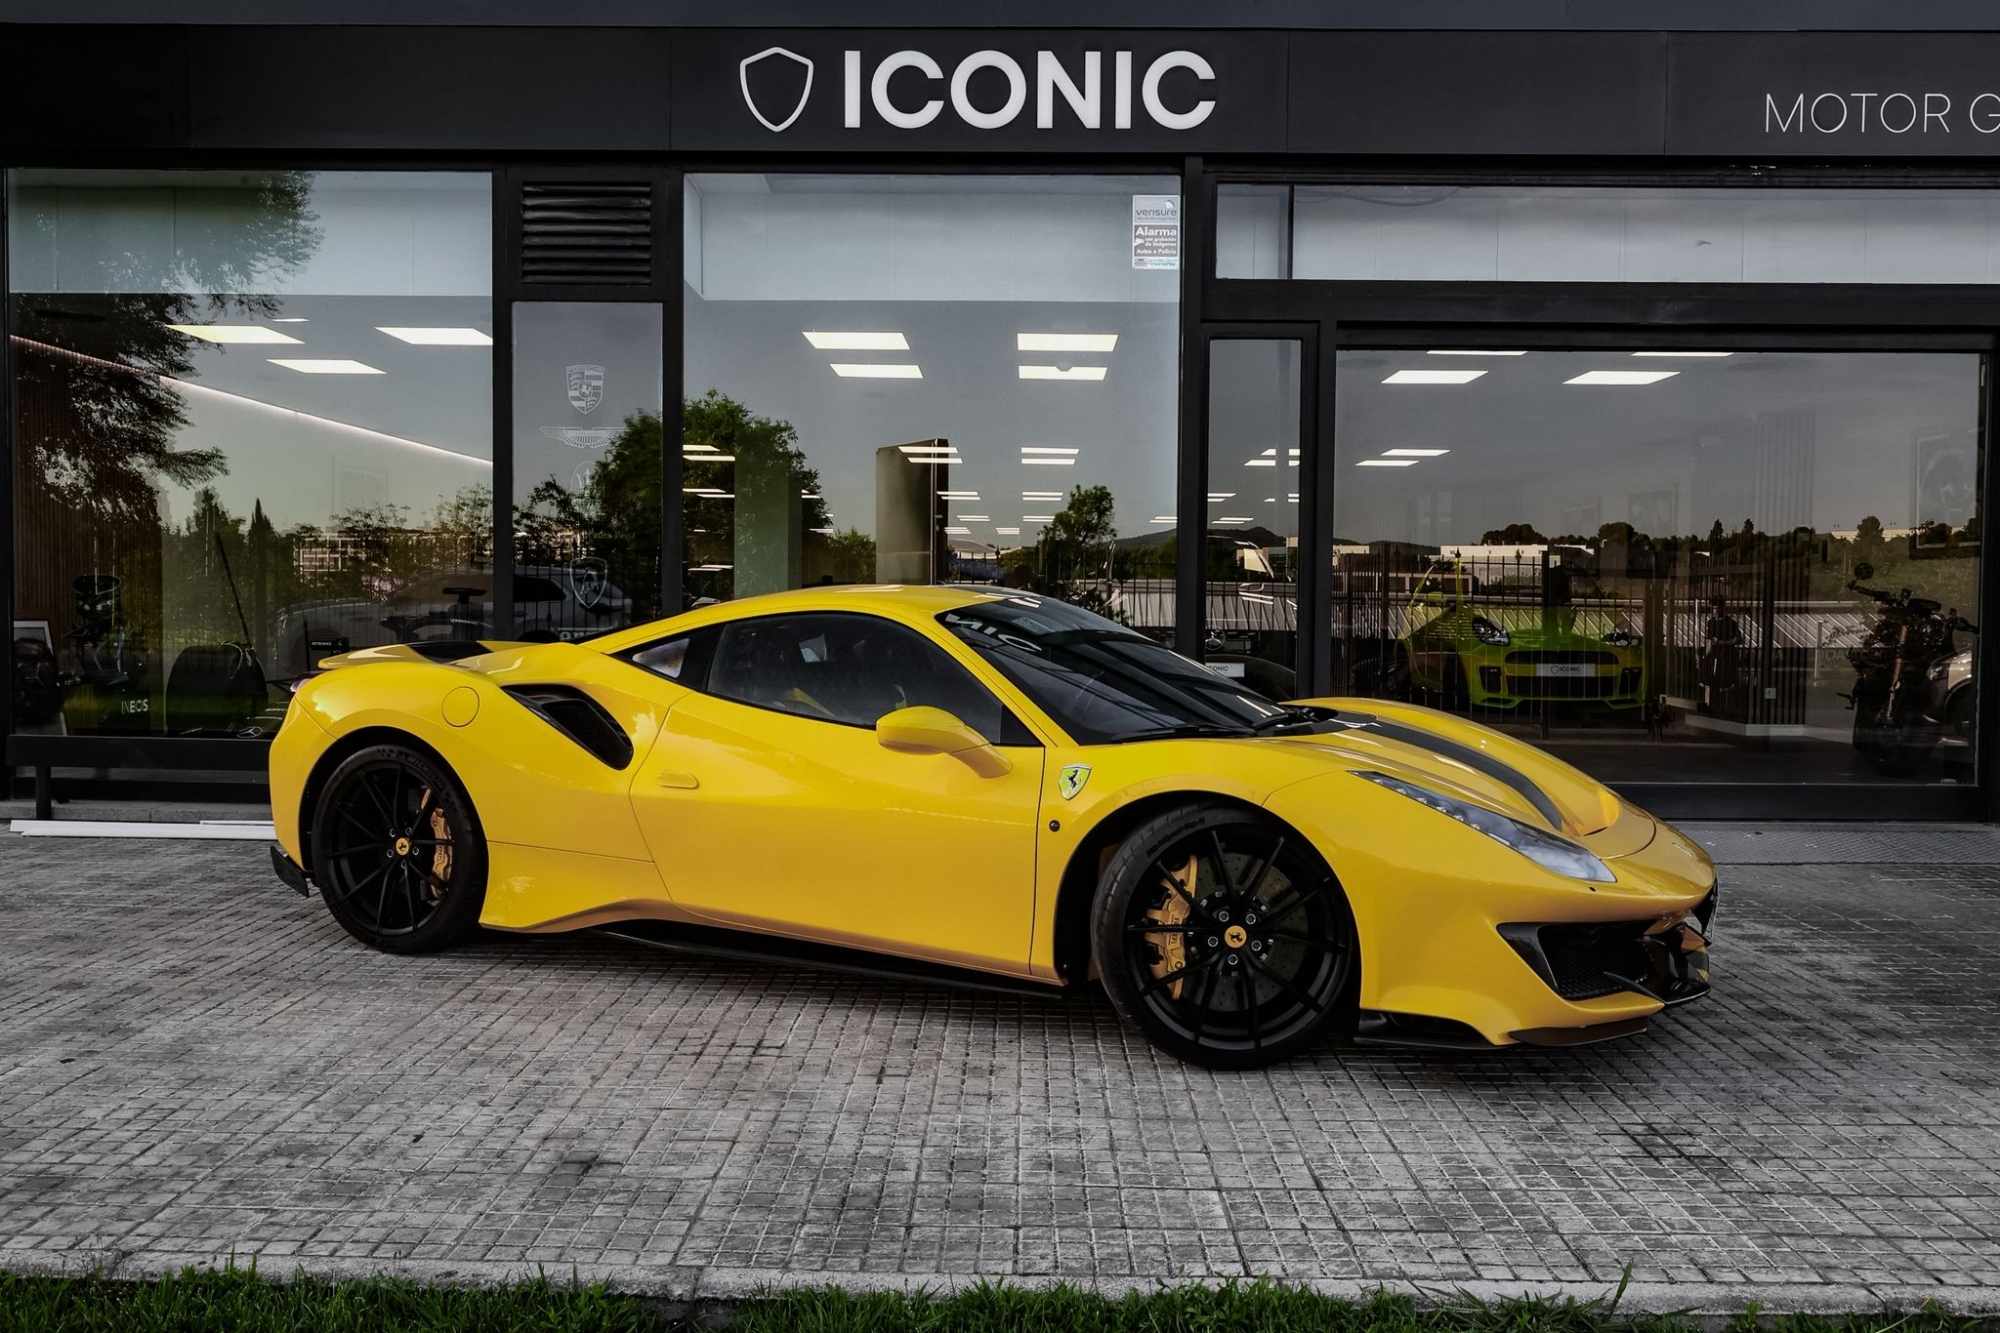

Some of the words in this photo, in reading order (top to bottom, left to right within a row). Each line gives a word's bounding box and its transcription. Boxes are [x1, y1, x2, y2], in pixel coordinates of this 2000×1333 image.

[844, 50, 1216, 130] ICONIC
[1765, 92, 1951, 133] MOTOR
[1136, 208, 1177, 217] verisure
[1135, 226, 1177, 236] Alarma
[121, 698, 149, 715] INEOS
